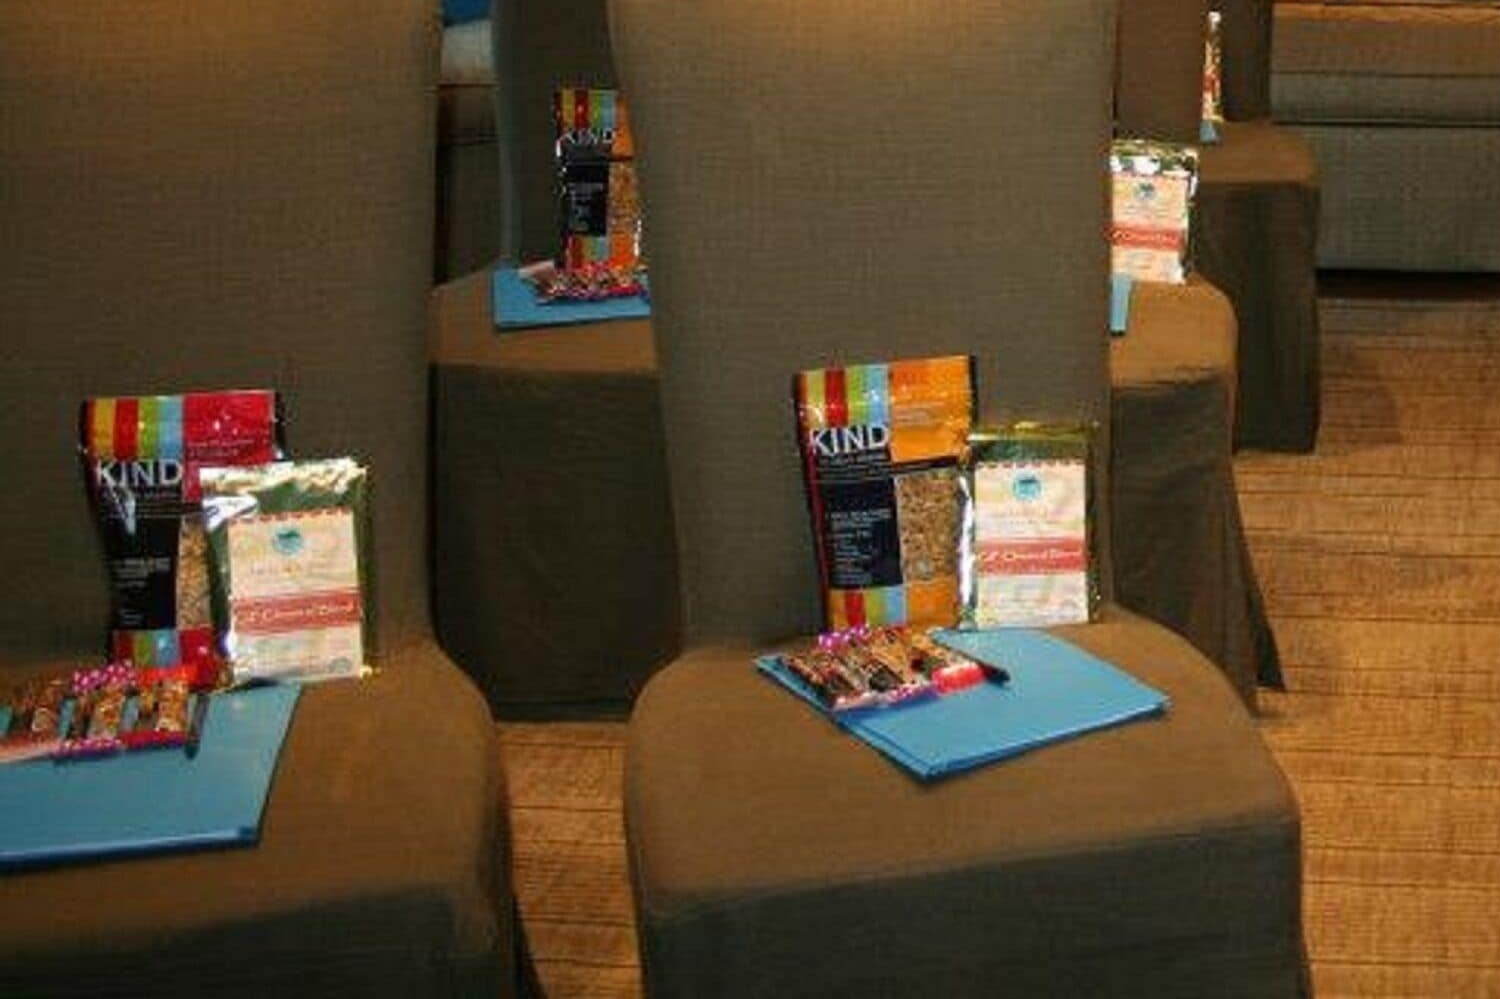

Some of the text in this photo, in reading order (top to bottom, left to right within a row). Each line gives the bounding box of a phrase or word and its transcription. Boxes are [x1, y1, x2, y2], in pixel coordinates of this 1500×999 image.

[562, 127, 616, 145] KIND
[808, 424, 889, 454] KIND
[95, 458, 184, 485] KIND
